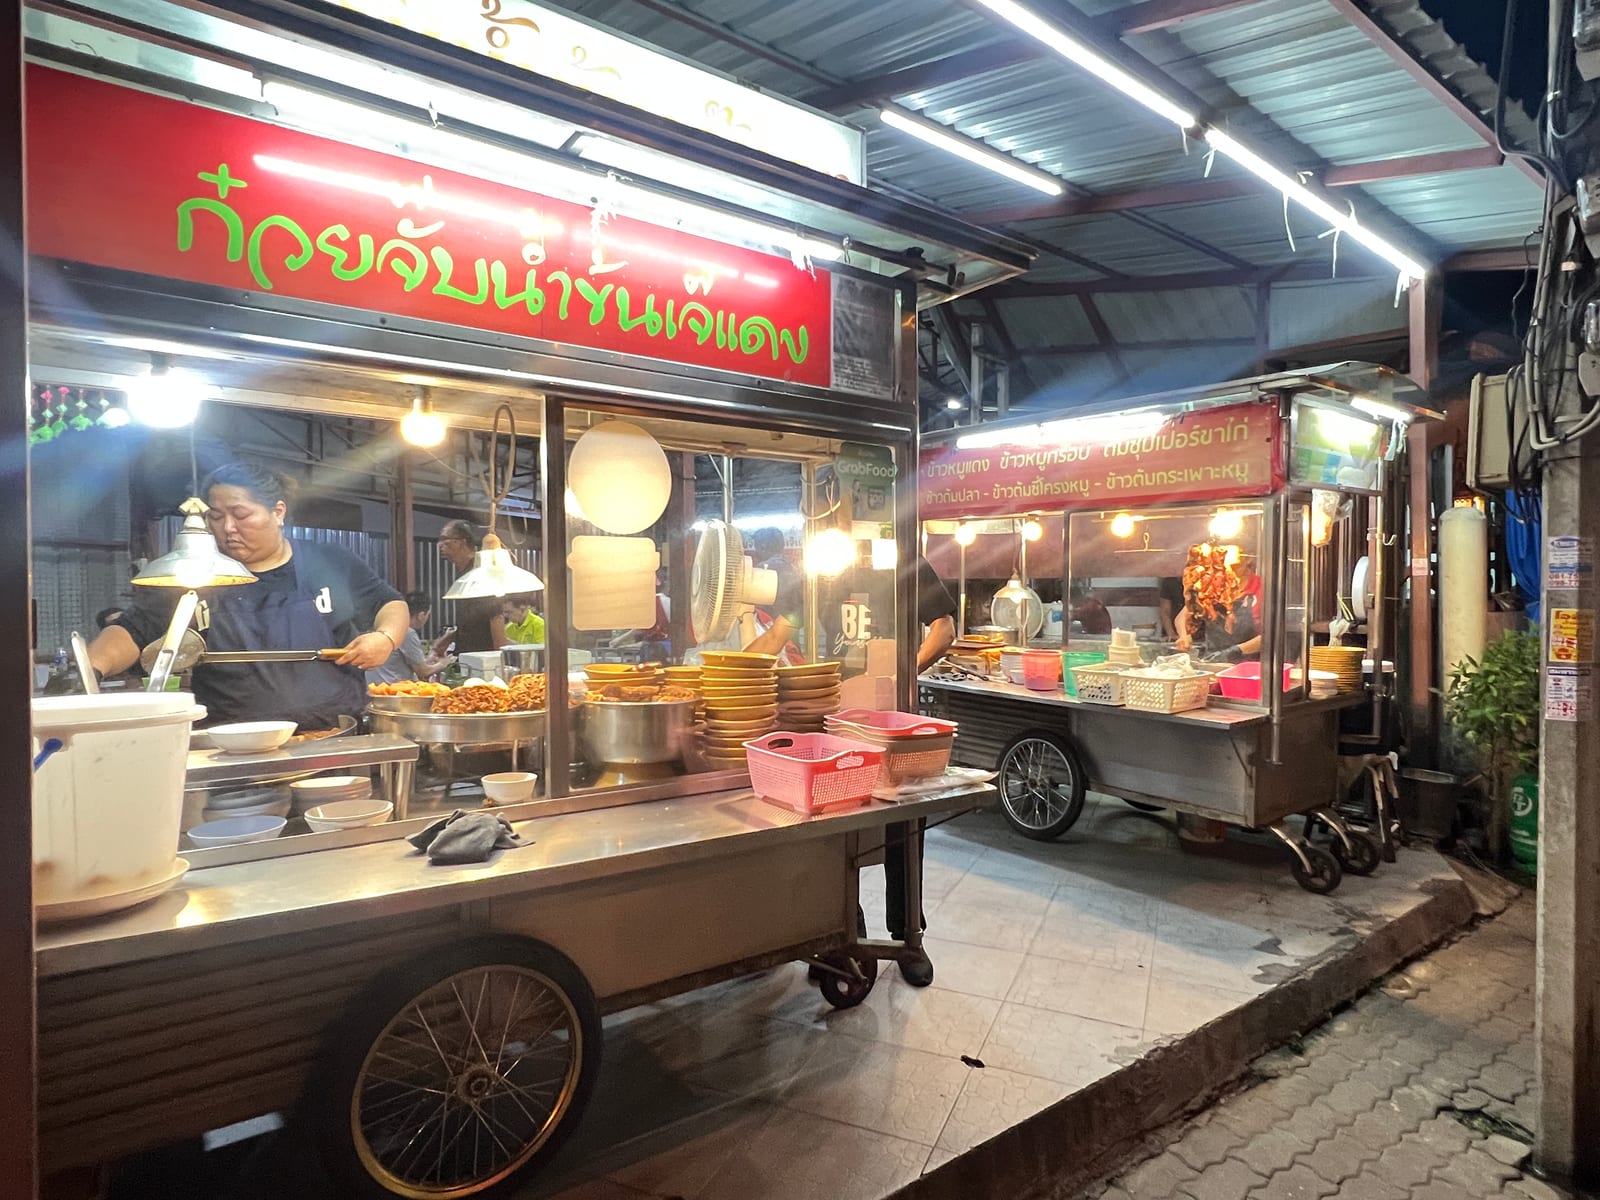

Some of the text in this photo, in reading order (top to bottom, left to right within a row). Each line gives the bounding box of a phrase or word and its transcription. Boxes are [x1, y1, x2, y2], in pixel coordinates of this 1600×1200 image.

[1103, 416, 1249, 461] ตมซุปเปอร์ขาไก่
[838, 460, 895, 478] GrabFood
[841, 604, 872, 640] BE
